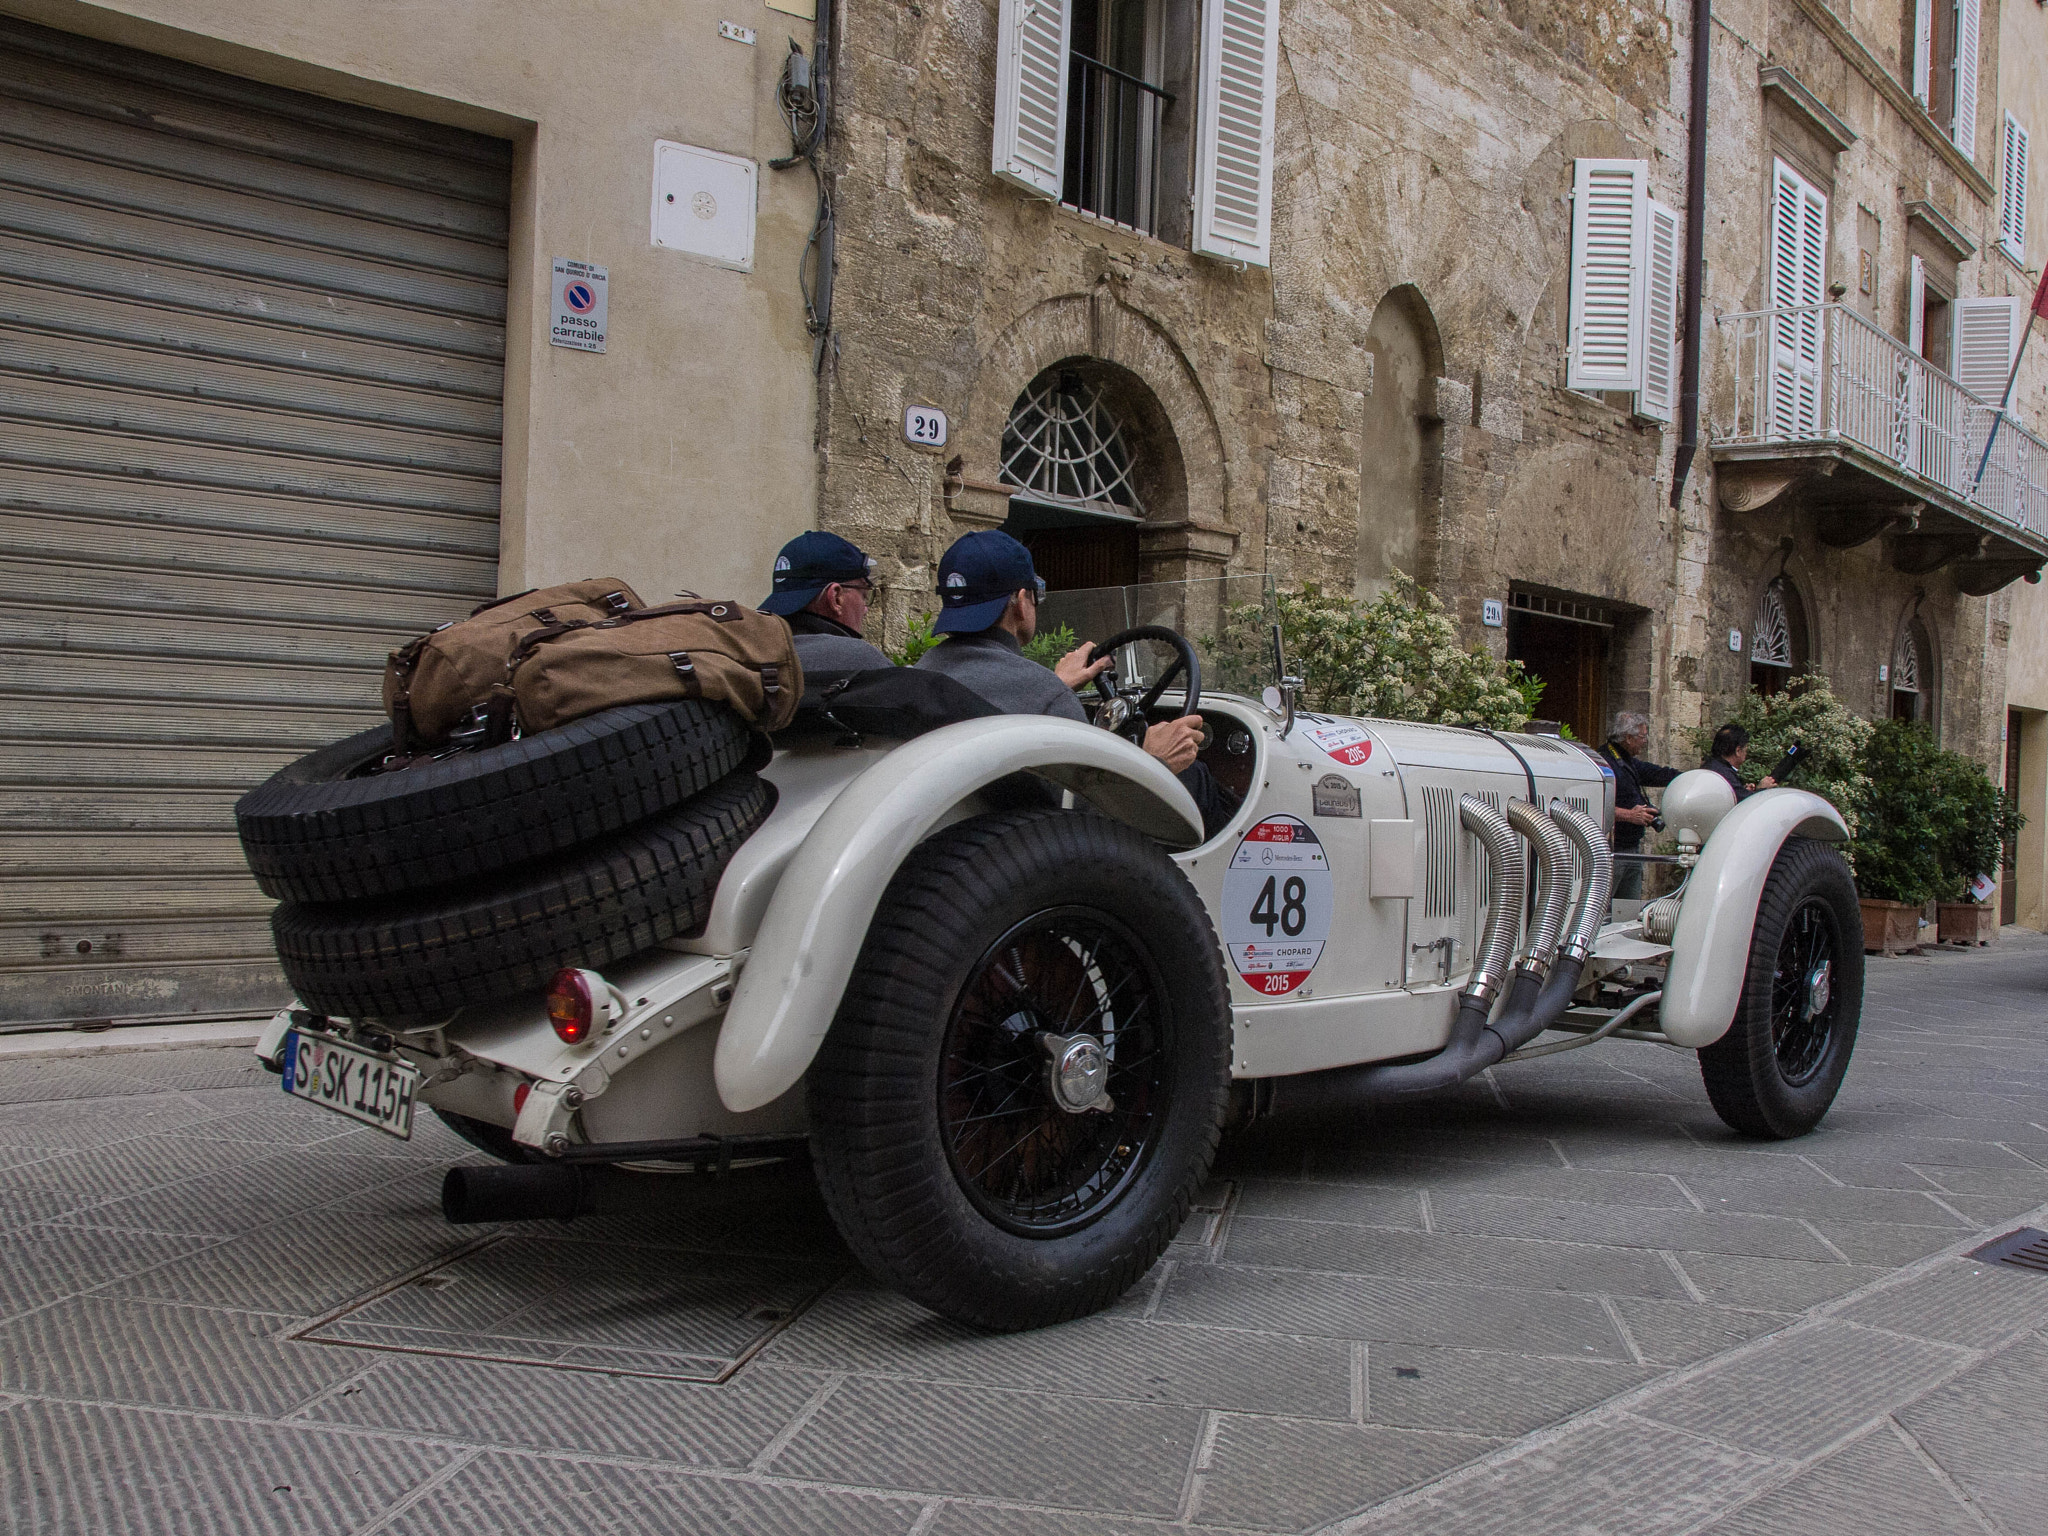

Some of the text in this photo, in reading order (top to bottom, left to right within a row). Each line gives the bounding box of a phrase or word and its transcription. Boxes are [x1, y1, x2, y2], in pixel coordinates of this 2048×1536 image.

[554, 266, 565, 274] SAN
[566, 268, 585, 278] QUIRICO
[592, 273, 606, 281] ORCIA
[567, 261, 588, 270] COMUNE
[561, 315, 598, 328] passo
[552, 326, 605, 342] carrabile
[914, 415, 939, 440] 29
[1485, 605, 1501, 622] 29A
[1345, 746, 1366, 764] 2015
[1273, 825, 1288, 833] 1000
[1249, 874, 1307, 938] 48
[1277, 948, 1312, 956] CHOPARD
[1264, 974, 1290, 992] 2015
[296, 1042, 311, 1089] S
[323, 1051, 354, 1106] SK
[354, 1062, 414, 1130] 115H
